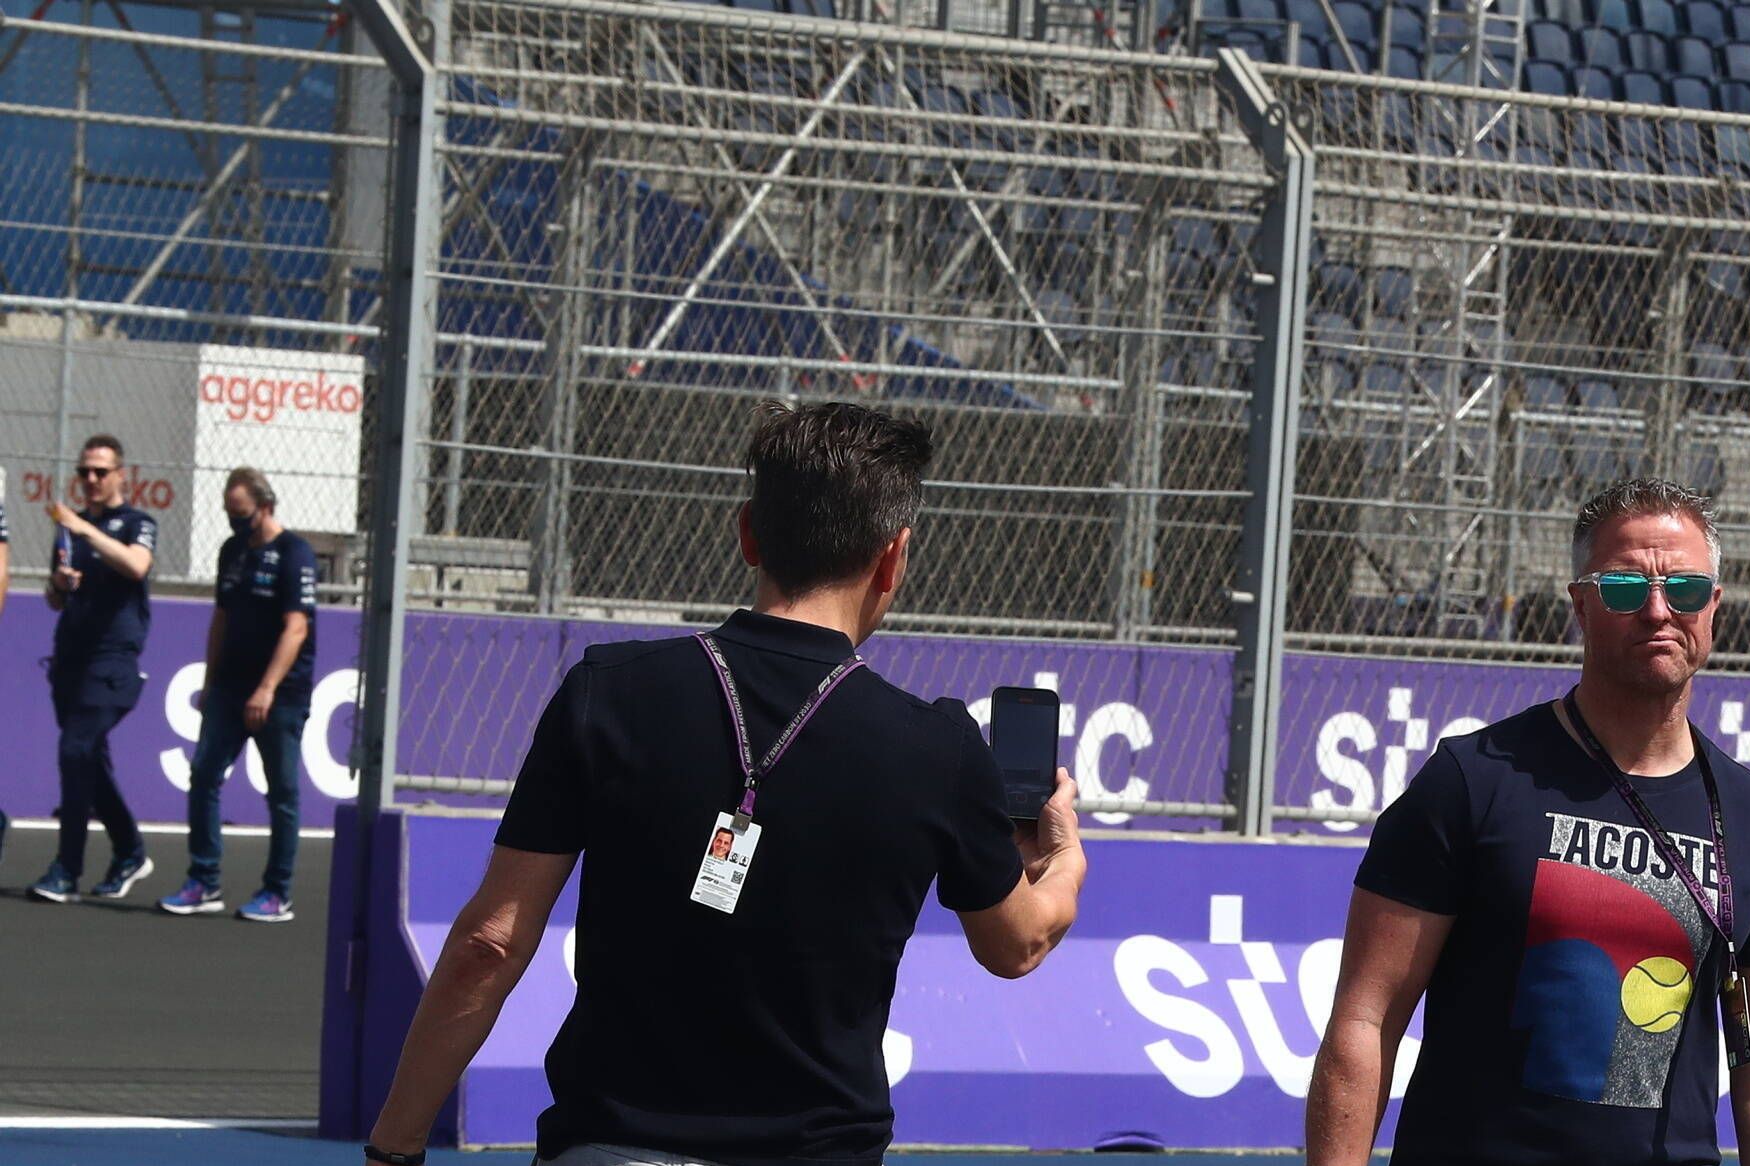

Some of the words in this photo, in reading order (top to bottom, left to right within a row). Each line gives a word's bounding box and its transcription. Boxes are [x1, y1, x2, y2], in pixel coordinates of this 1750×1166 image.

[201, 370, 362, 422] aggreko
[1311, 687, 1488, 832] st
[1538, 814, 1718, 889] LACOSTE
